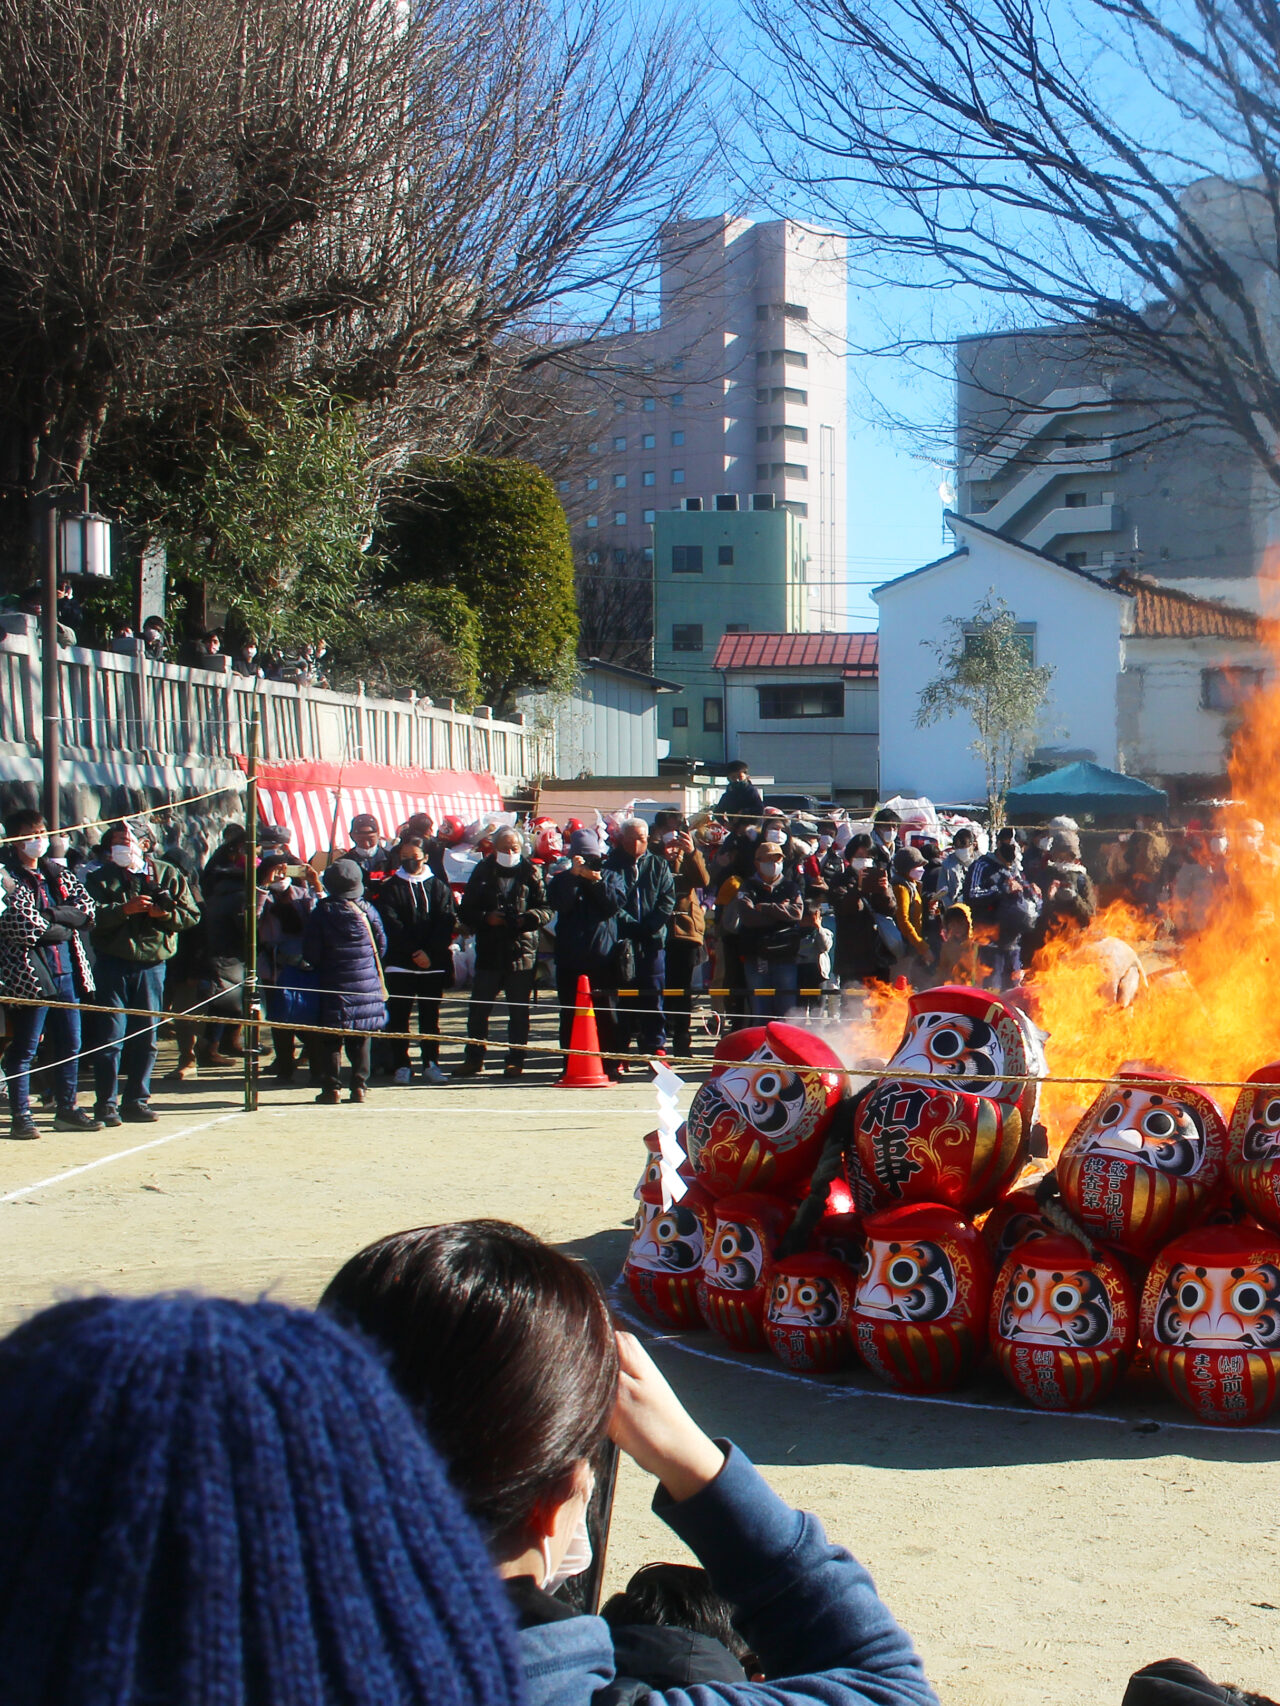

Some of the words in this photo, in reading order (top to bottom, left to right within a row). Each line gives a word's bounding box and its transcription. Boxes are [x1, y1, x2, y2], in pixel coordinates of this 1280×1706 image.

[1081, 1158, 1107, 1236] 捜査第一
[1104, 1160, 1128, 1239] 警視庁
[1191, 1353, 1221, 1421] まちづくり
